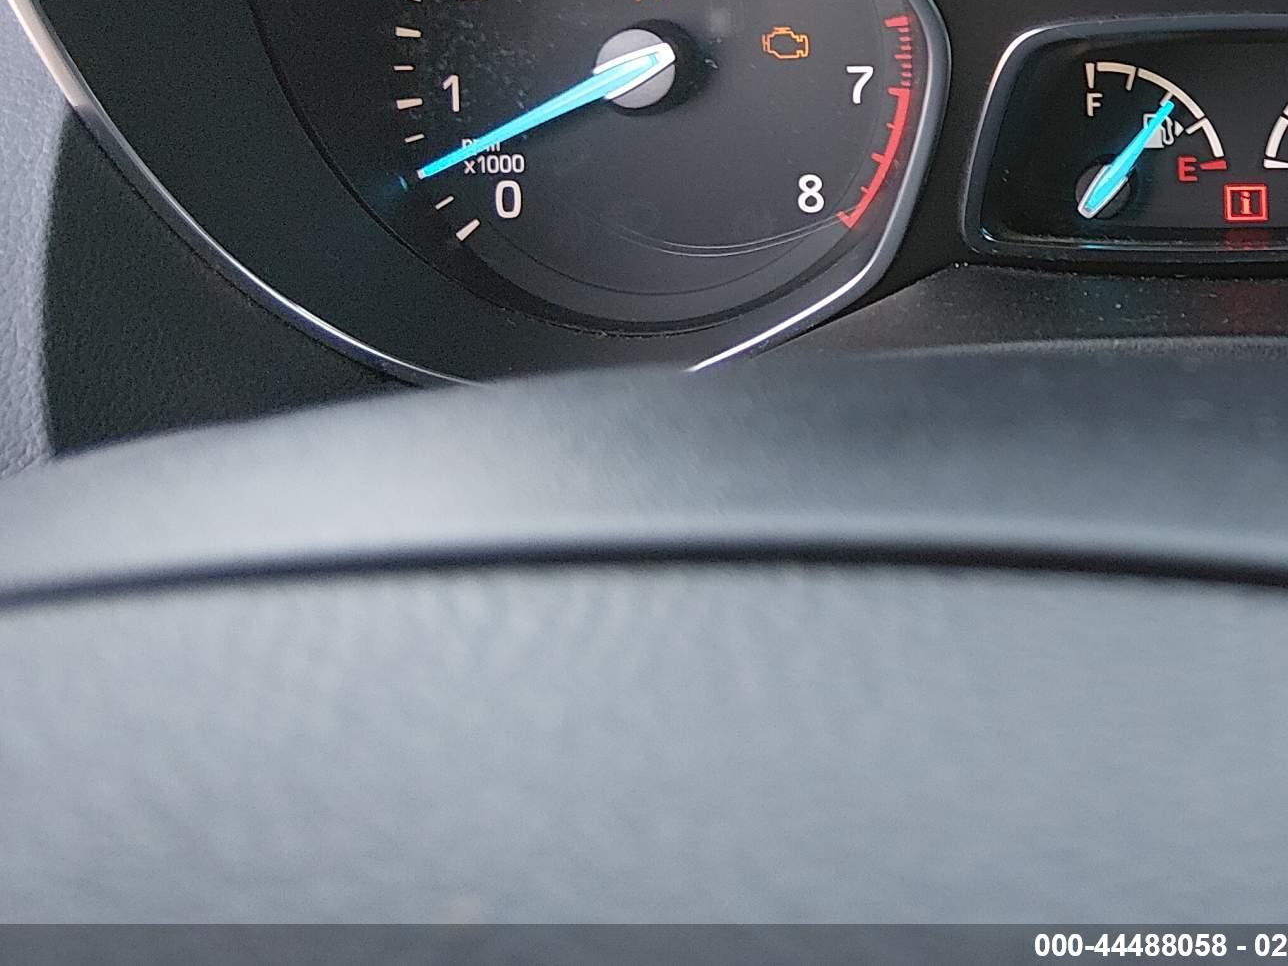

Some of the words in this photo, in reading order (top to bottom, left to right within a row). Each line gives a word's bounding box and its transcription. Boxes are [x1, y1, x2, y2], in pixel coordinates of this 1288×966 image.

[442, 74, 460, 112] 1
[846, 65, 874, 104] 7
[1086, 92, 1103, 117] F
[463, 154, 525, 174] x1000
[1178, 156, 1198, 182] E
[495, 180, 522, 219] 0
[797, 174, 825, 213] 8
